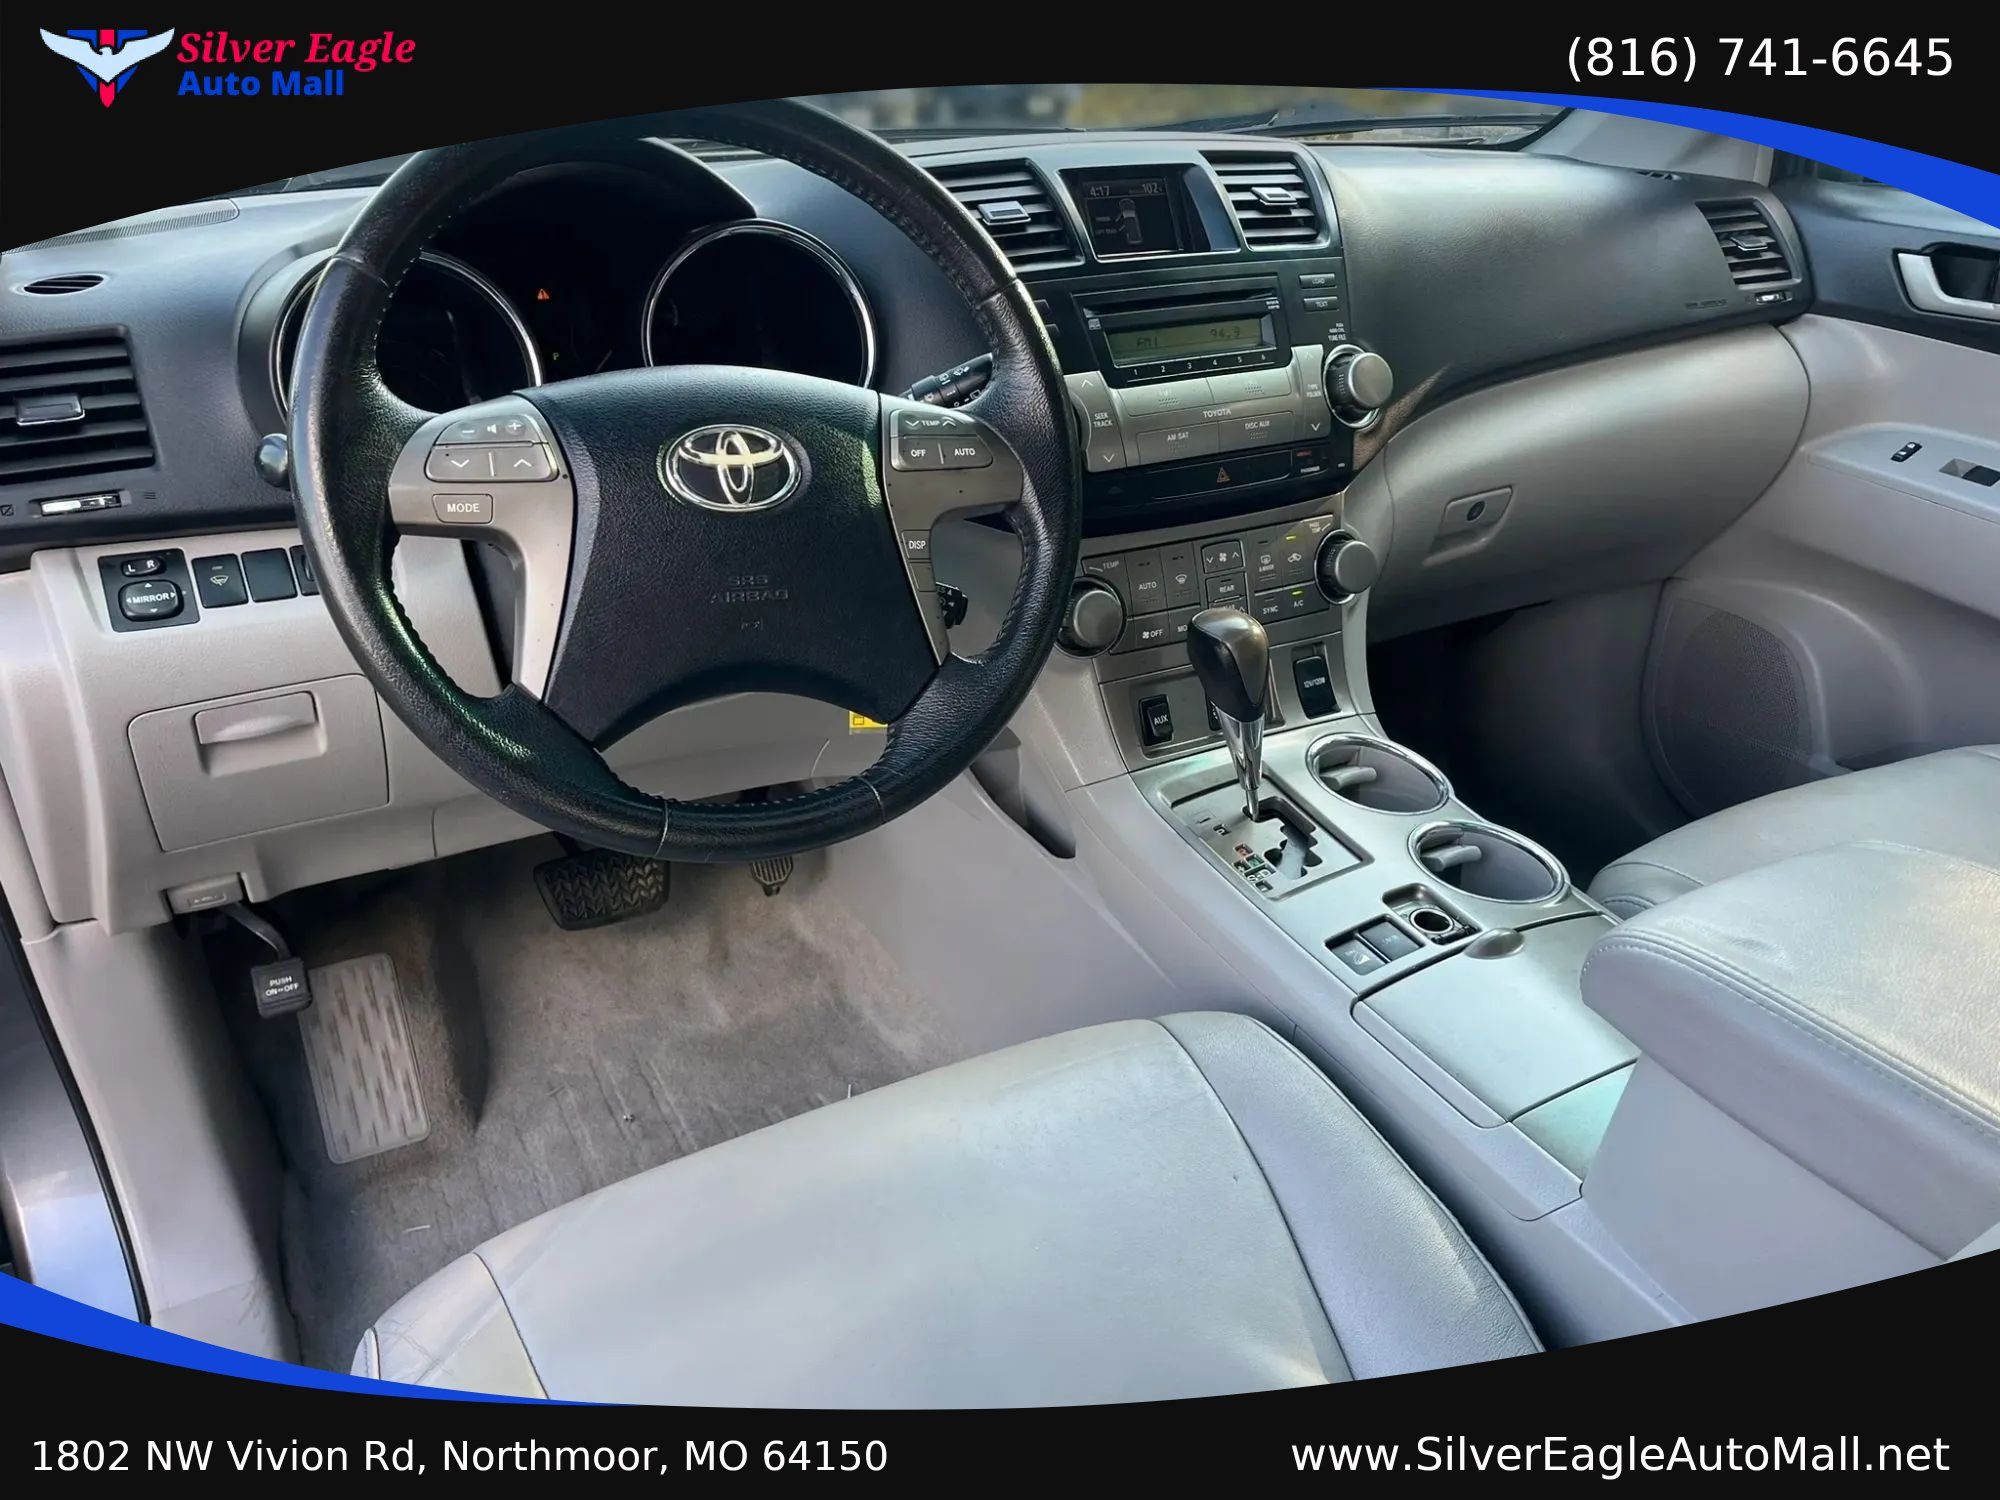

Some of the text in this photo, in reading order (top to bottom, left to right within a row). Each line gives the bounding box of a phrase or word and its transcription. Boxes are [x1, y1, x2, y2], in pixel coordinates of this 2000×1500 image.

[1090, 185, 1110, 197] 4:17
[1202, 409, 1232, 419] TOYOTA
[910, 449, 926, 457] OFF
[954, 448, 975, 456] AUTO
[447, 503, 481, 513] MODE
[908, 540, 926, 550] DISP
[127, 559, 155, 573] L R
[1102, 560, 1120, 569] TEMP
[1138, 581, 1157, 590] AUTO
[133, 592, 170, 604] MIRROR
[710, 588, 789, 604] AIRBAG
[1150, 628, 1164, 637] OFF
[1154, 715, 1169, 726] AUX
[269, 975, 292, 987] PUSH
